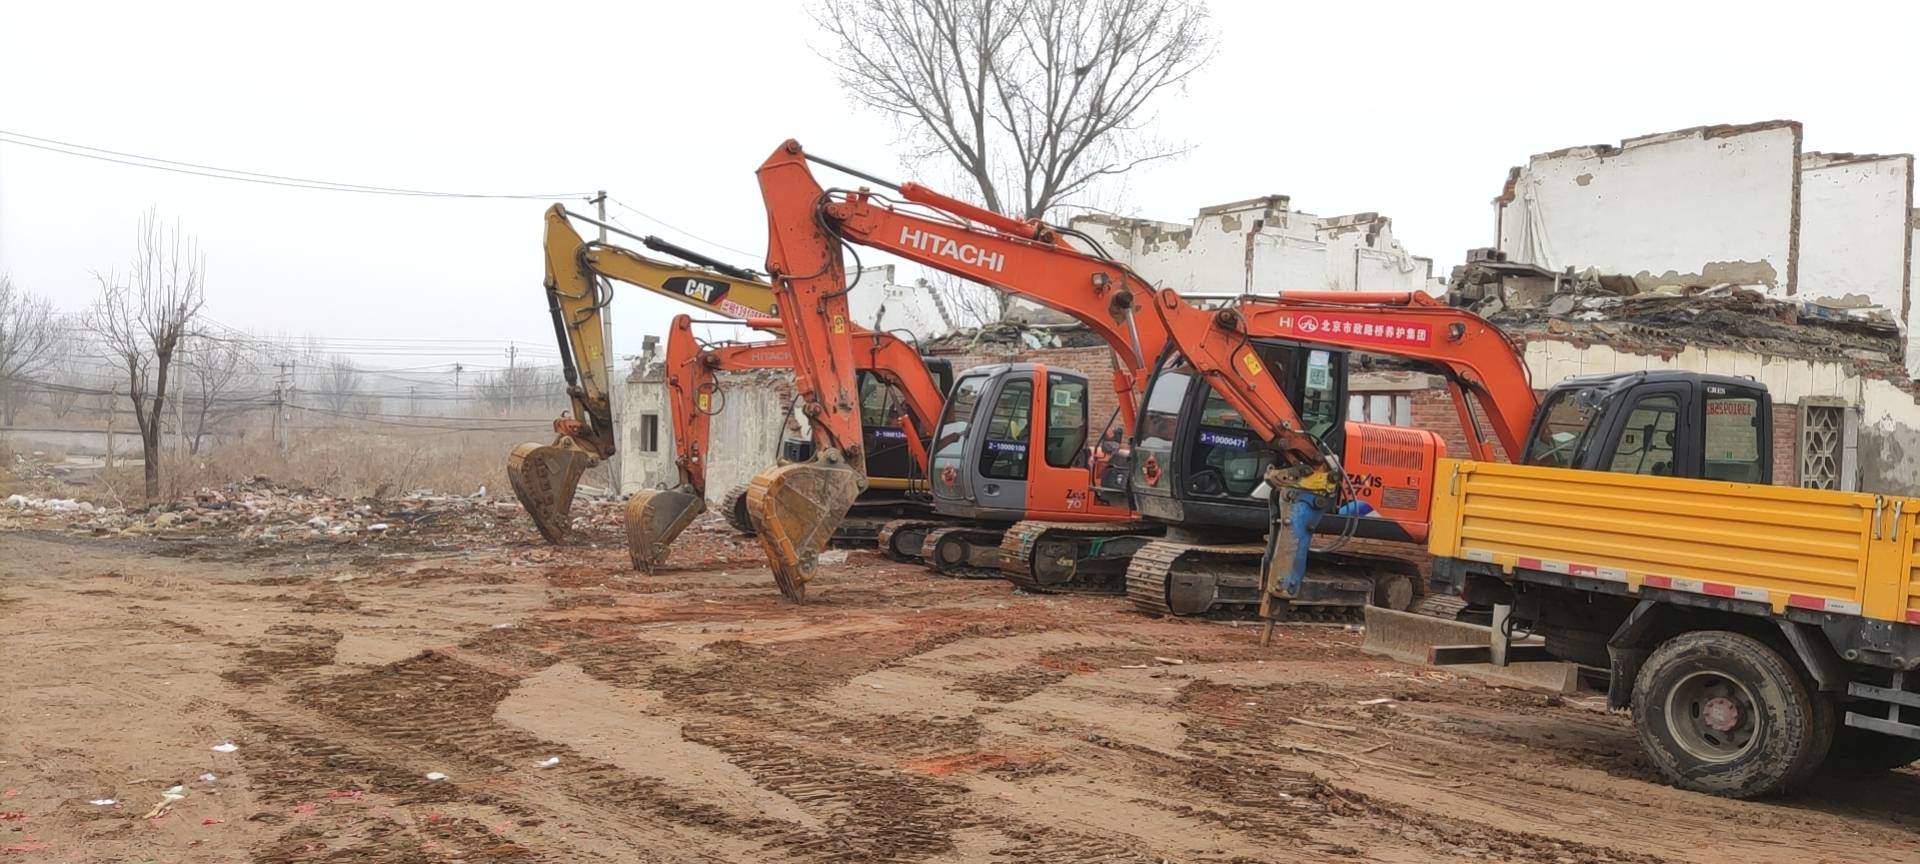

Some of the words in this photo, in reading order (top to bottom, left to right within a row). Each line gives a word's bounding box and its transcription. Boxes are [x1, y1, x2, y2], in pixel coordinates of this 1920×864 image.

[900, 226, 1005, 272] HITACHI
[685, 279, 714, 302] CAT
[1321, 319, 1427, 341] 北京市政路桥养护集团
